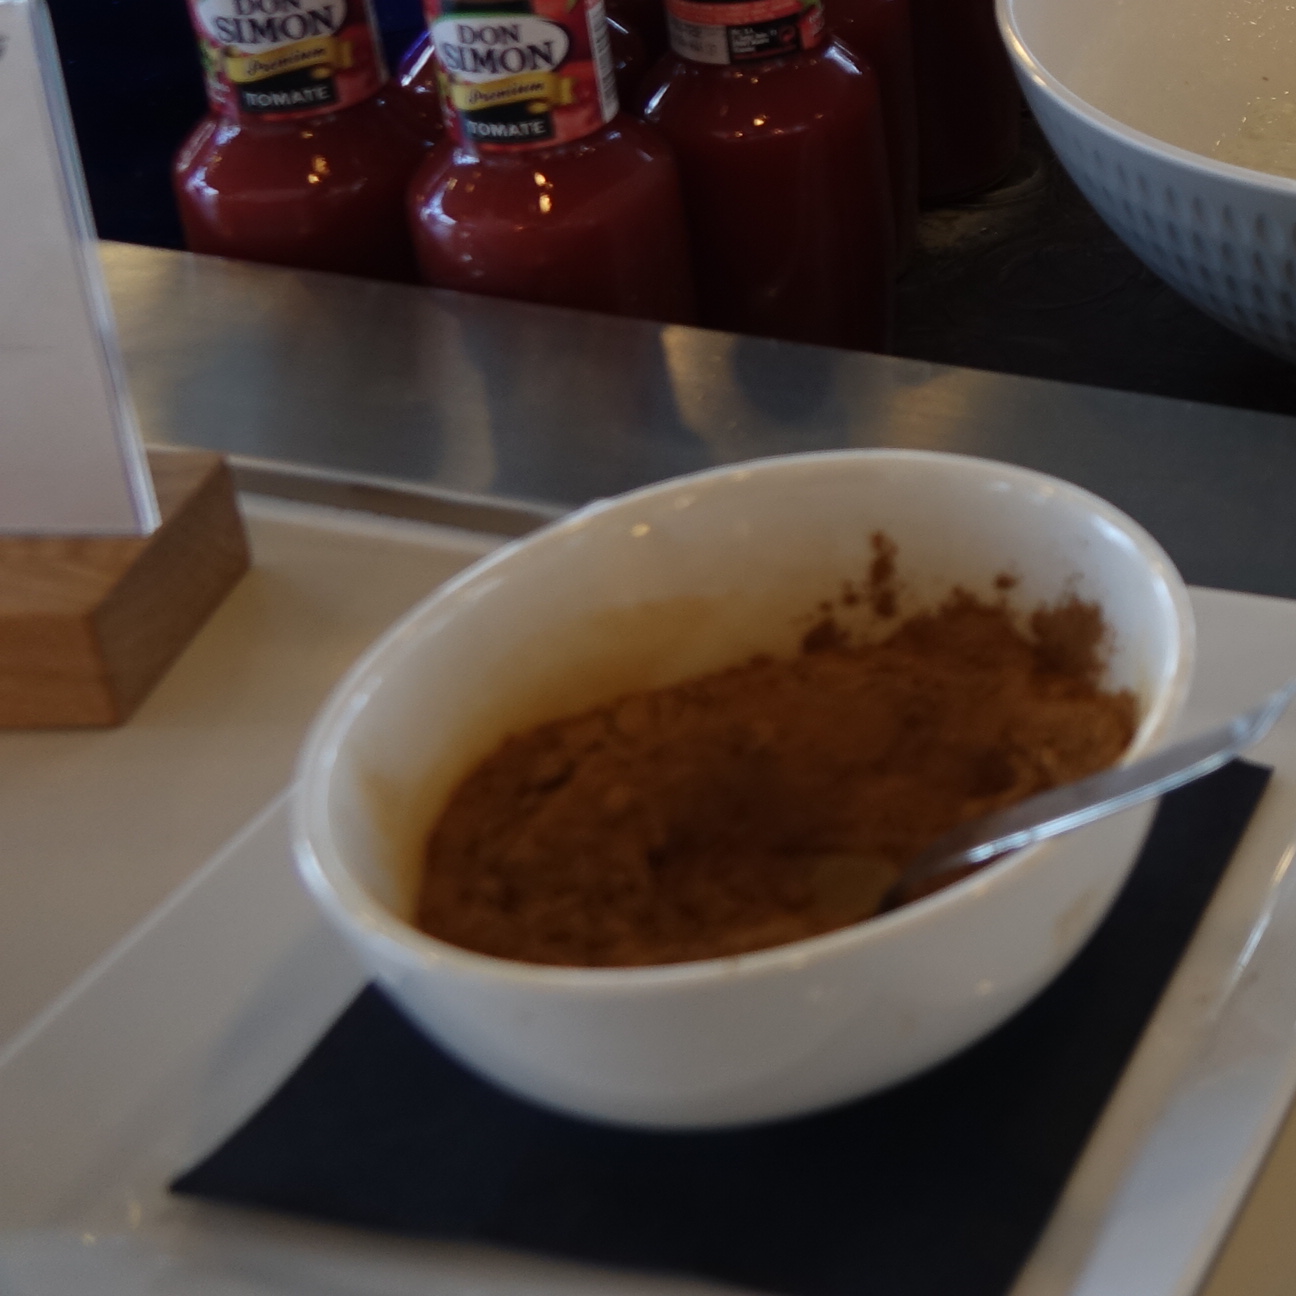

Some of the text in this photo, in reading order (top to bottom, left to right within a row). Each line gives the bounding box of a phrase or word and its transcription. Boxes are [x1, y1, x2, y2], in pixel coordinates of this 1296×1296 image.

[213, 6, 337, 44] SIMON
[457, 23, 523, 45] DON
[443, 41, 557, 74] SIMON
[243, 86, 331, 107] TOMATE
[466, 120, 546, 137] TOMATE
